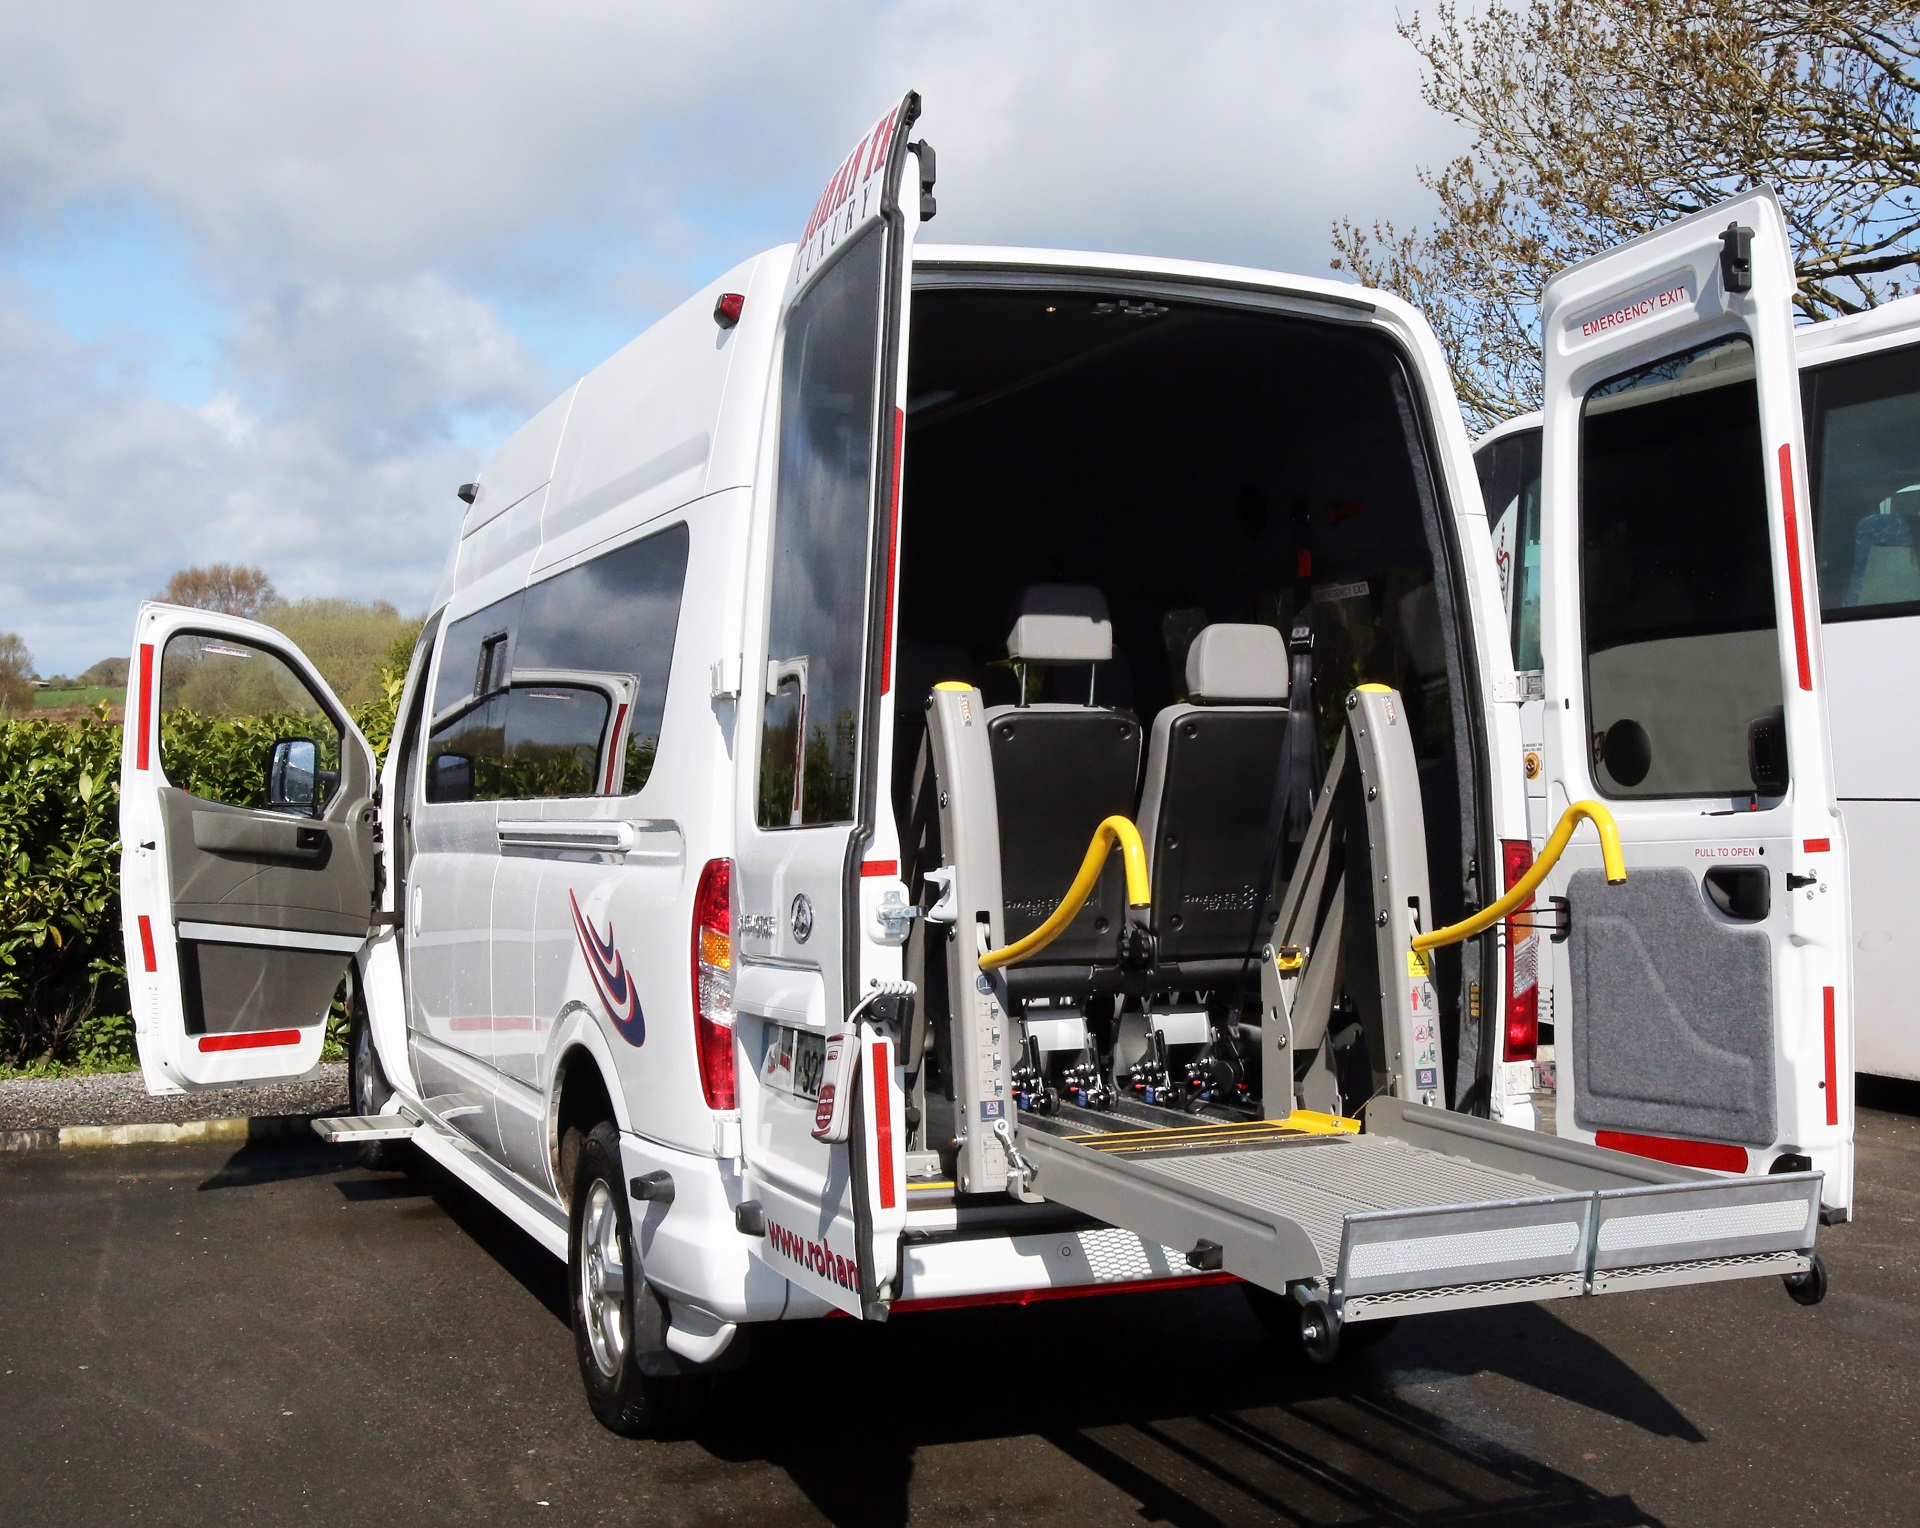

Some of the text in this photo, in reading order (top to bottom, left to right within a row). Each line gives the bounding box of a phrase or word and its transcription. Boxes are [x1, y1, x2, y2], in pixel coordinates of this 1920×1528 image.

[796, 183, 873, 286] LUXURY
[1582, 286, 1685, 336] EMERGENCY EXIT
[1695, 848, 1755, 857] PULL TO OPEN
[767, 1218, 860, 1295] www.rohan
